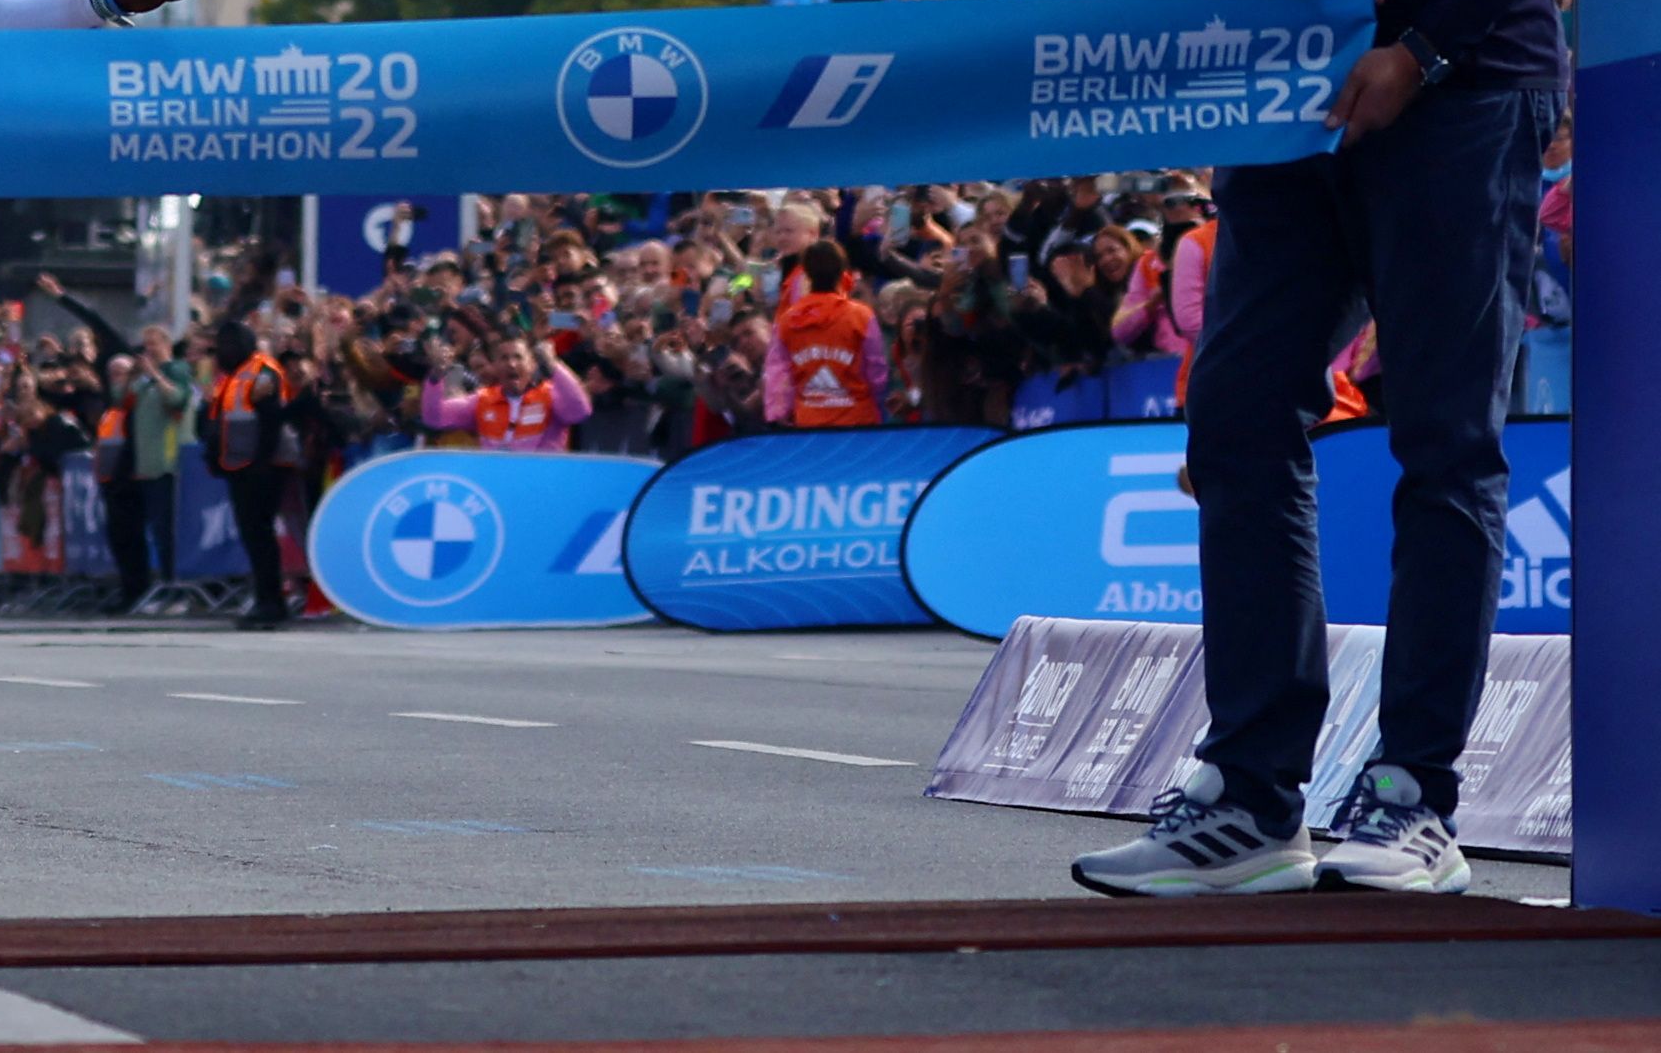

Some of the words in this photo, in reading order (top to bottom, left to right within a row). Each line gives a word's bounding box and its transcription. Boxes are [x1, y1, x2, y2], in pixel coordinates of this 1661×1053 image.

[577, 33, 687, 72] BMW
[1034, 31, 1171, 76] BMW
[1255, 24, 1334, 72] 20
[108, 58, 246, 97] BMW
[337, 52, 419, 102] 20
[1030, 73, 1167, 104] BERLIN
[109, 97, 249, 127] BERLIN
[1255, 75, 1333, 124] 22
[338, 106, 419, 160] 22
[1029, 101, 1250, 139] MARATHON
[109, 131, 332, 163] MARATHON
[386, 481, 486, 517] BMW
[689, 481, 929, 539] ERDINGE
